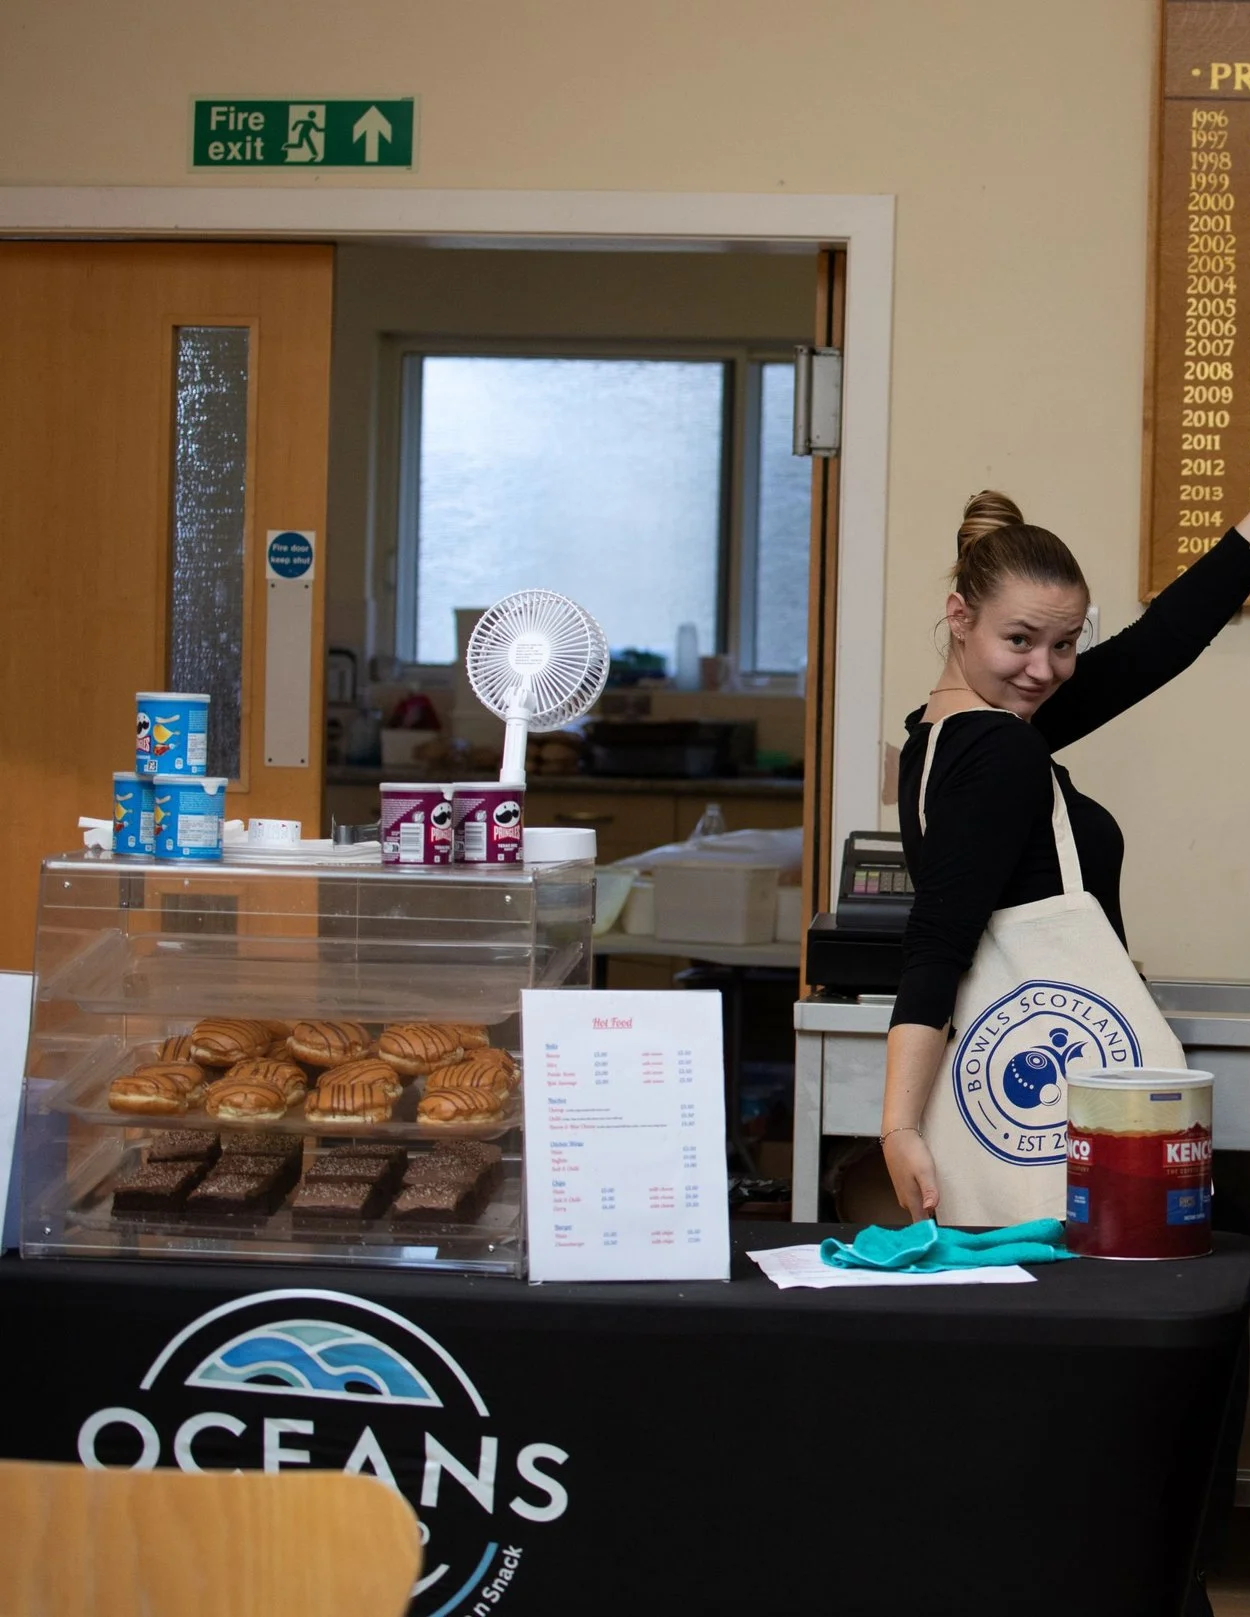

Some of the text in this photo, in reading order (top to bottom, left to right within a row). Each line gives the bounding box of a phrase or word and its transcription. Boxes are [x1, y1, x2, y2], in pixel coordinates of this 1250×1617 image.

[210, 106, 265, 131] Fire
[1191, 110, 1229, 129] 1996
[208, 136, 265, 160] exit
[1191, 132, 1227, 150] 1997
[1188, 194, 1234, 211] 2000
[1189, 215, 1231, 232] 2001
[1184, 339, 1234, 356] 2007
[1179, 511, 1223, 527] 2014
[272, 543, 309, 552] Fire door
[270, 556, 311, 565] keep shut
[592, 1016, 632, 1029] Hot Food
[965, 991, 1128, 1093] BOWLS SCOTLAND
[1017, 1134, 1046, 1152] EST
[77, 1406, 570, 1524] OCEANS
[482, 1545, 523, 1603] Snack
